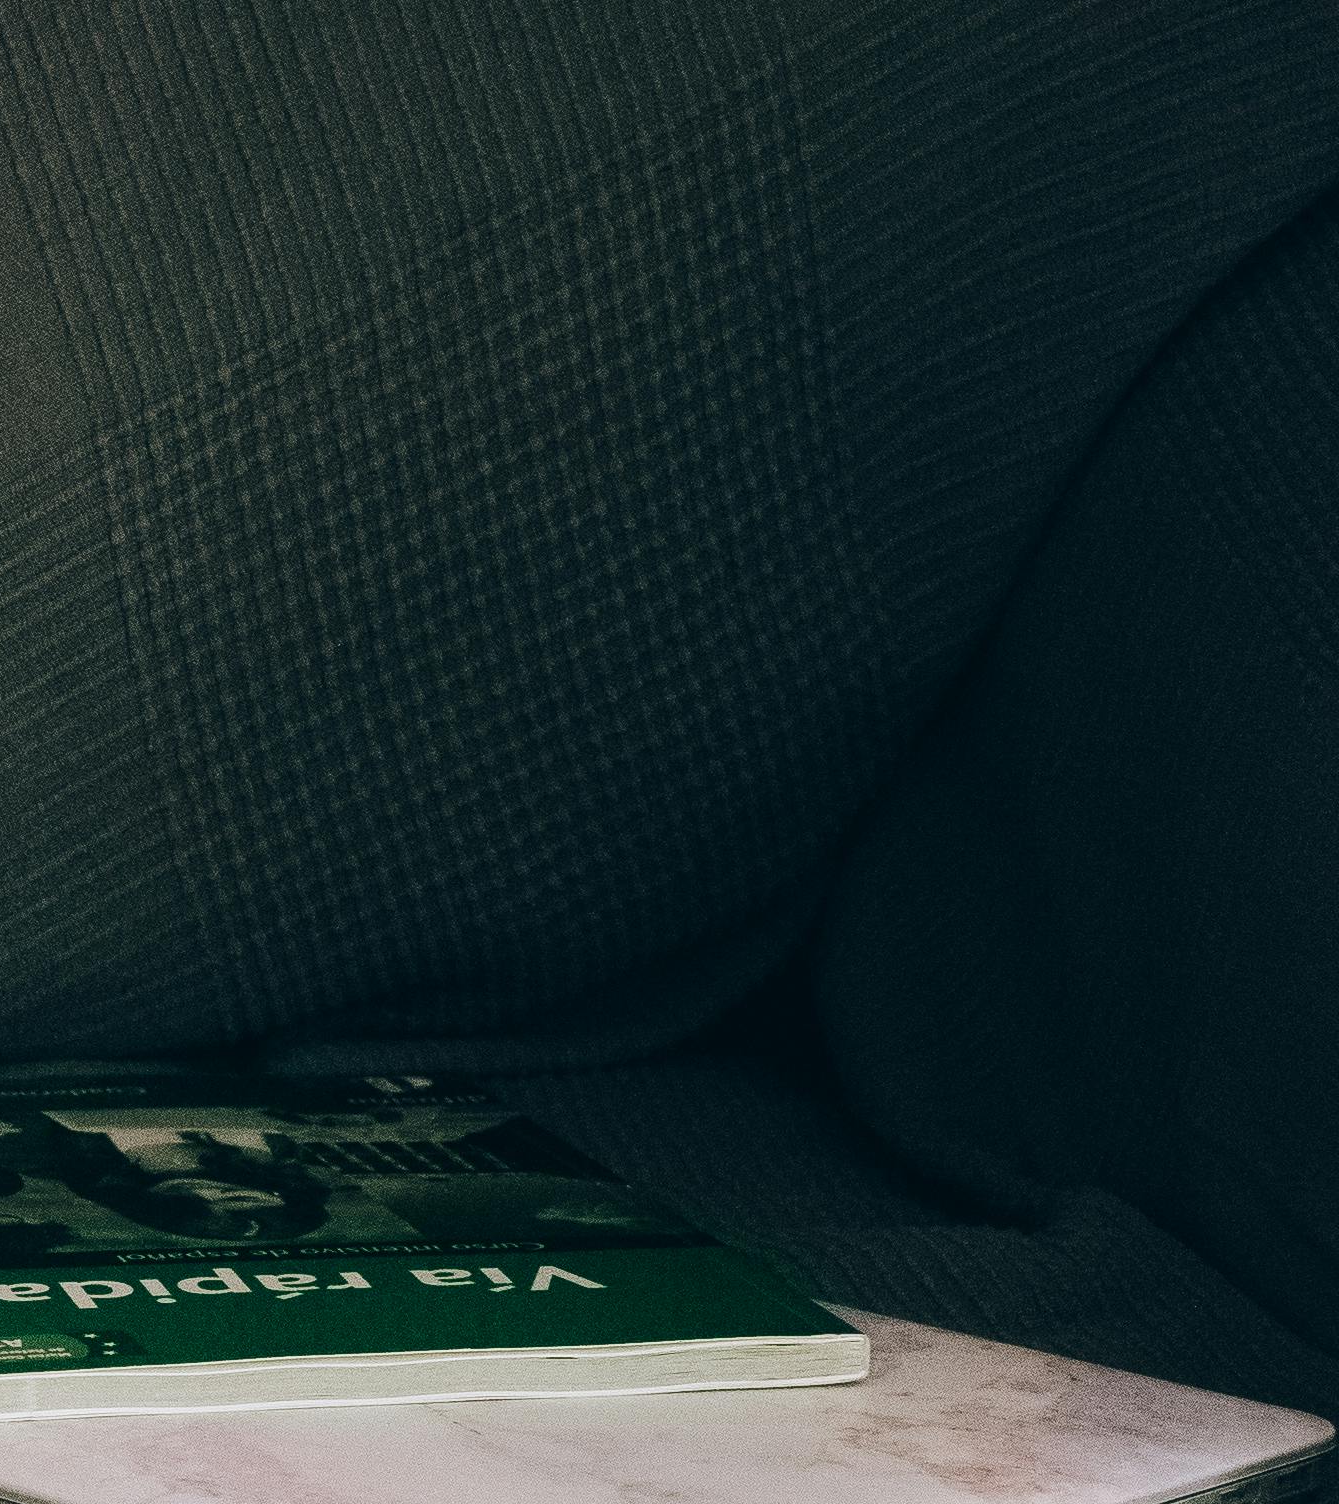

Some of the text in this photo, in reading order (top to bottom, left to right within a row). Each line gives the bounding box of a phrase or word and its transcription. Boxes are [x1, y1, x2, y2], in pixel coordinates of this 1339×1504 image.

[116, 1241, 545, 1265] Curso intensivo de español
[409, 1263, 607, 1294] Vía
